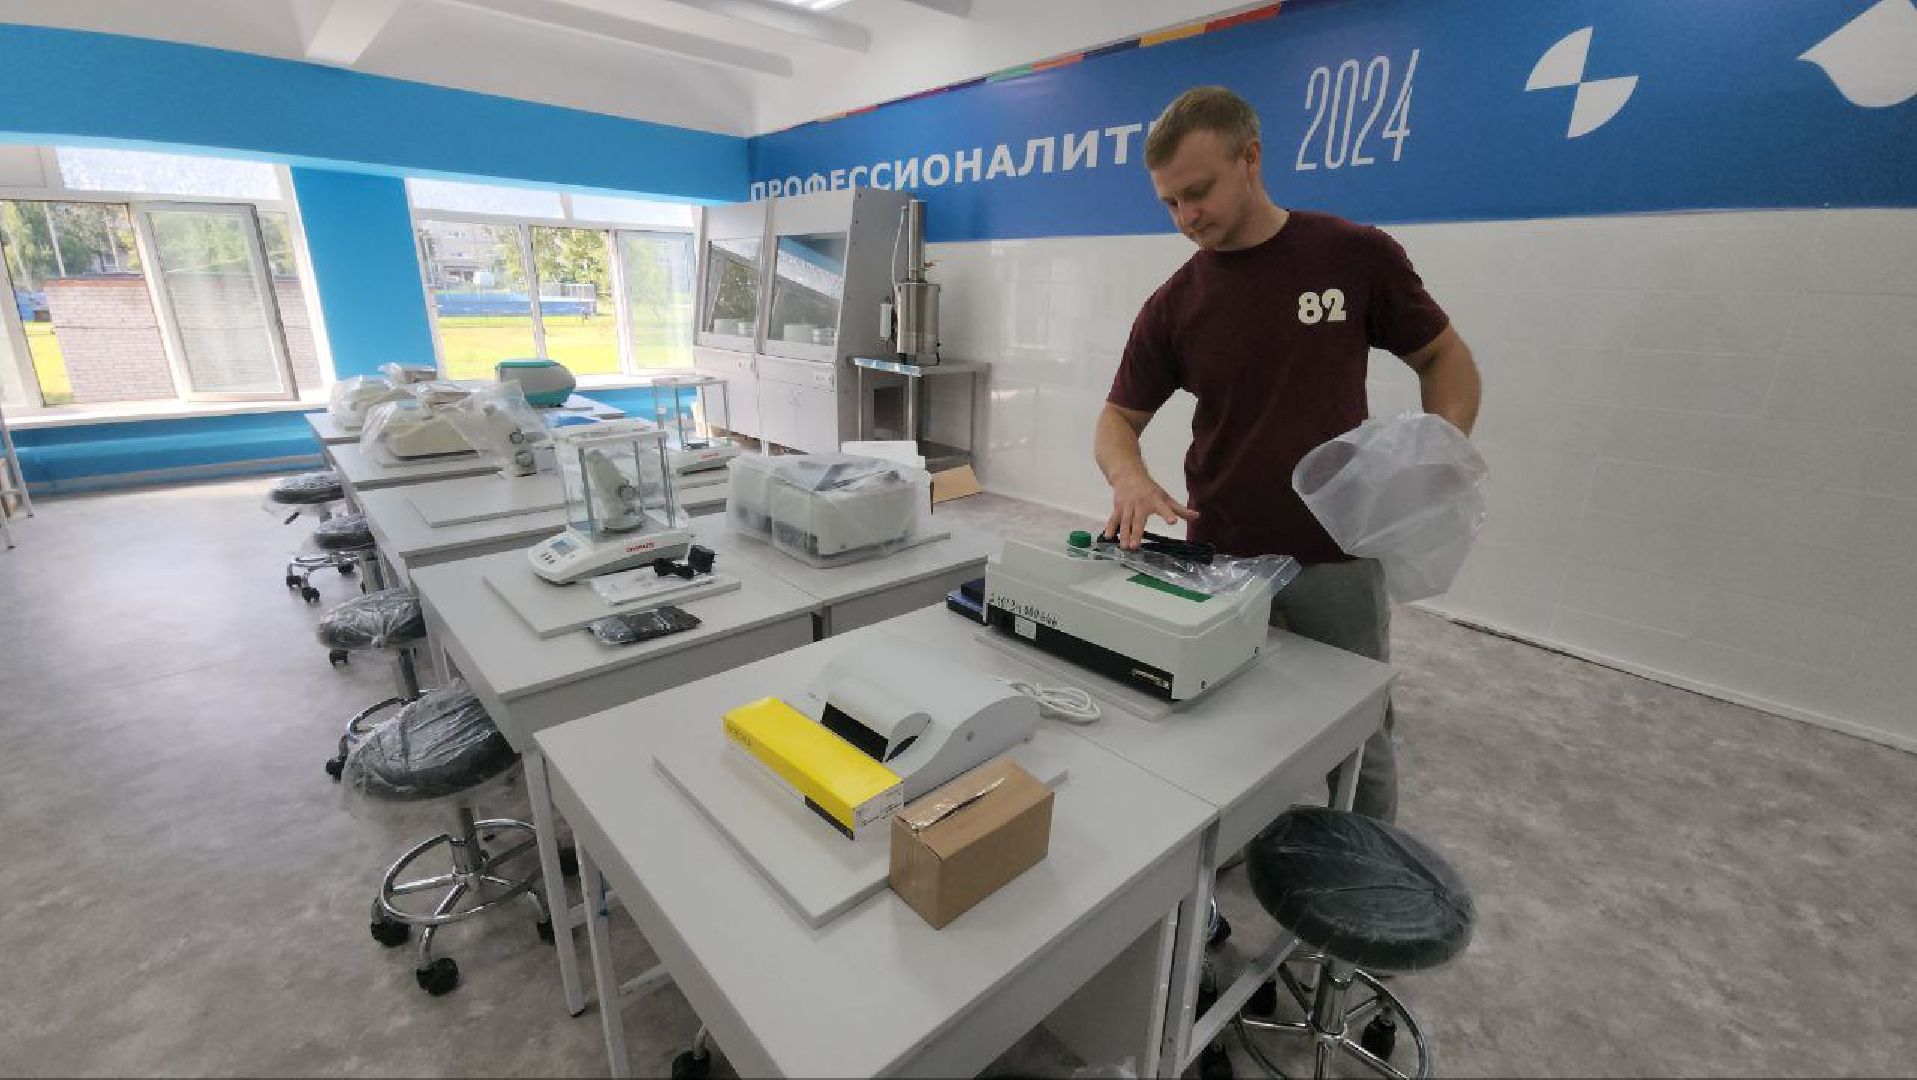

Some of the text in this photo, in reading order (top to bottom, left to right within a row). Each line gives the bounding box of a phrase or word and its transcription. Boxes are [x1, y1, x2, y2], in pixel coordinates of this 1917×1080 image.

[1296, 48, 1420, 171] 2024
[750, 121, 1159, 201] ПРОФЕССИОНАЛИТ
[1298, 288, 1347, 325] 82
